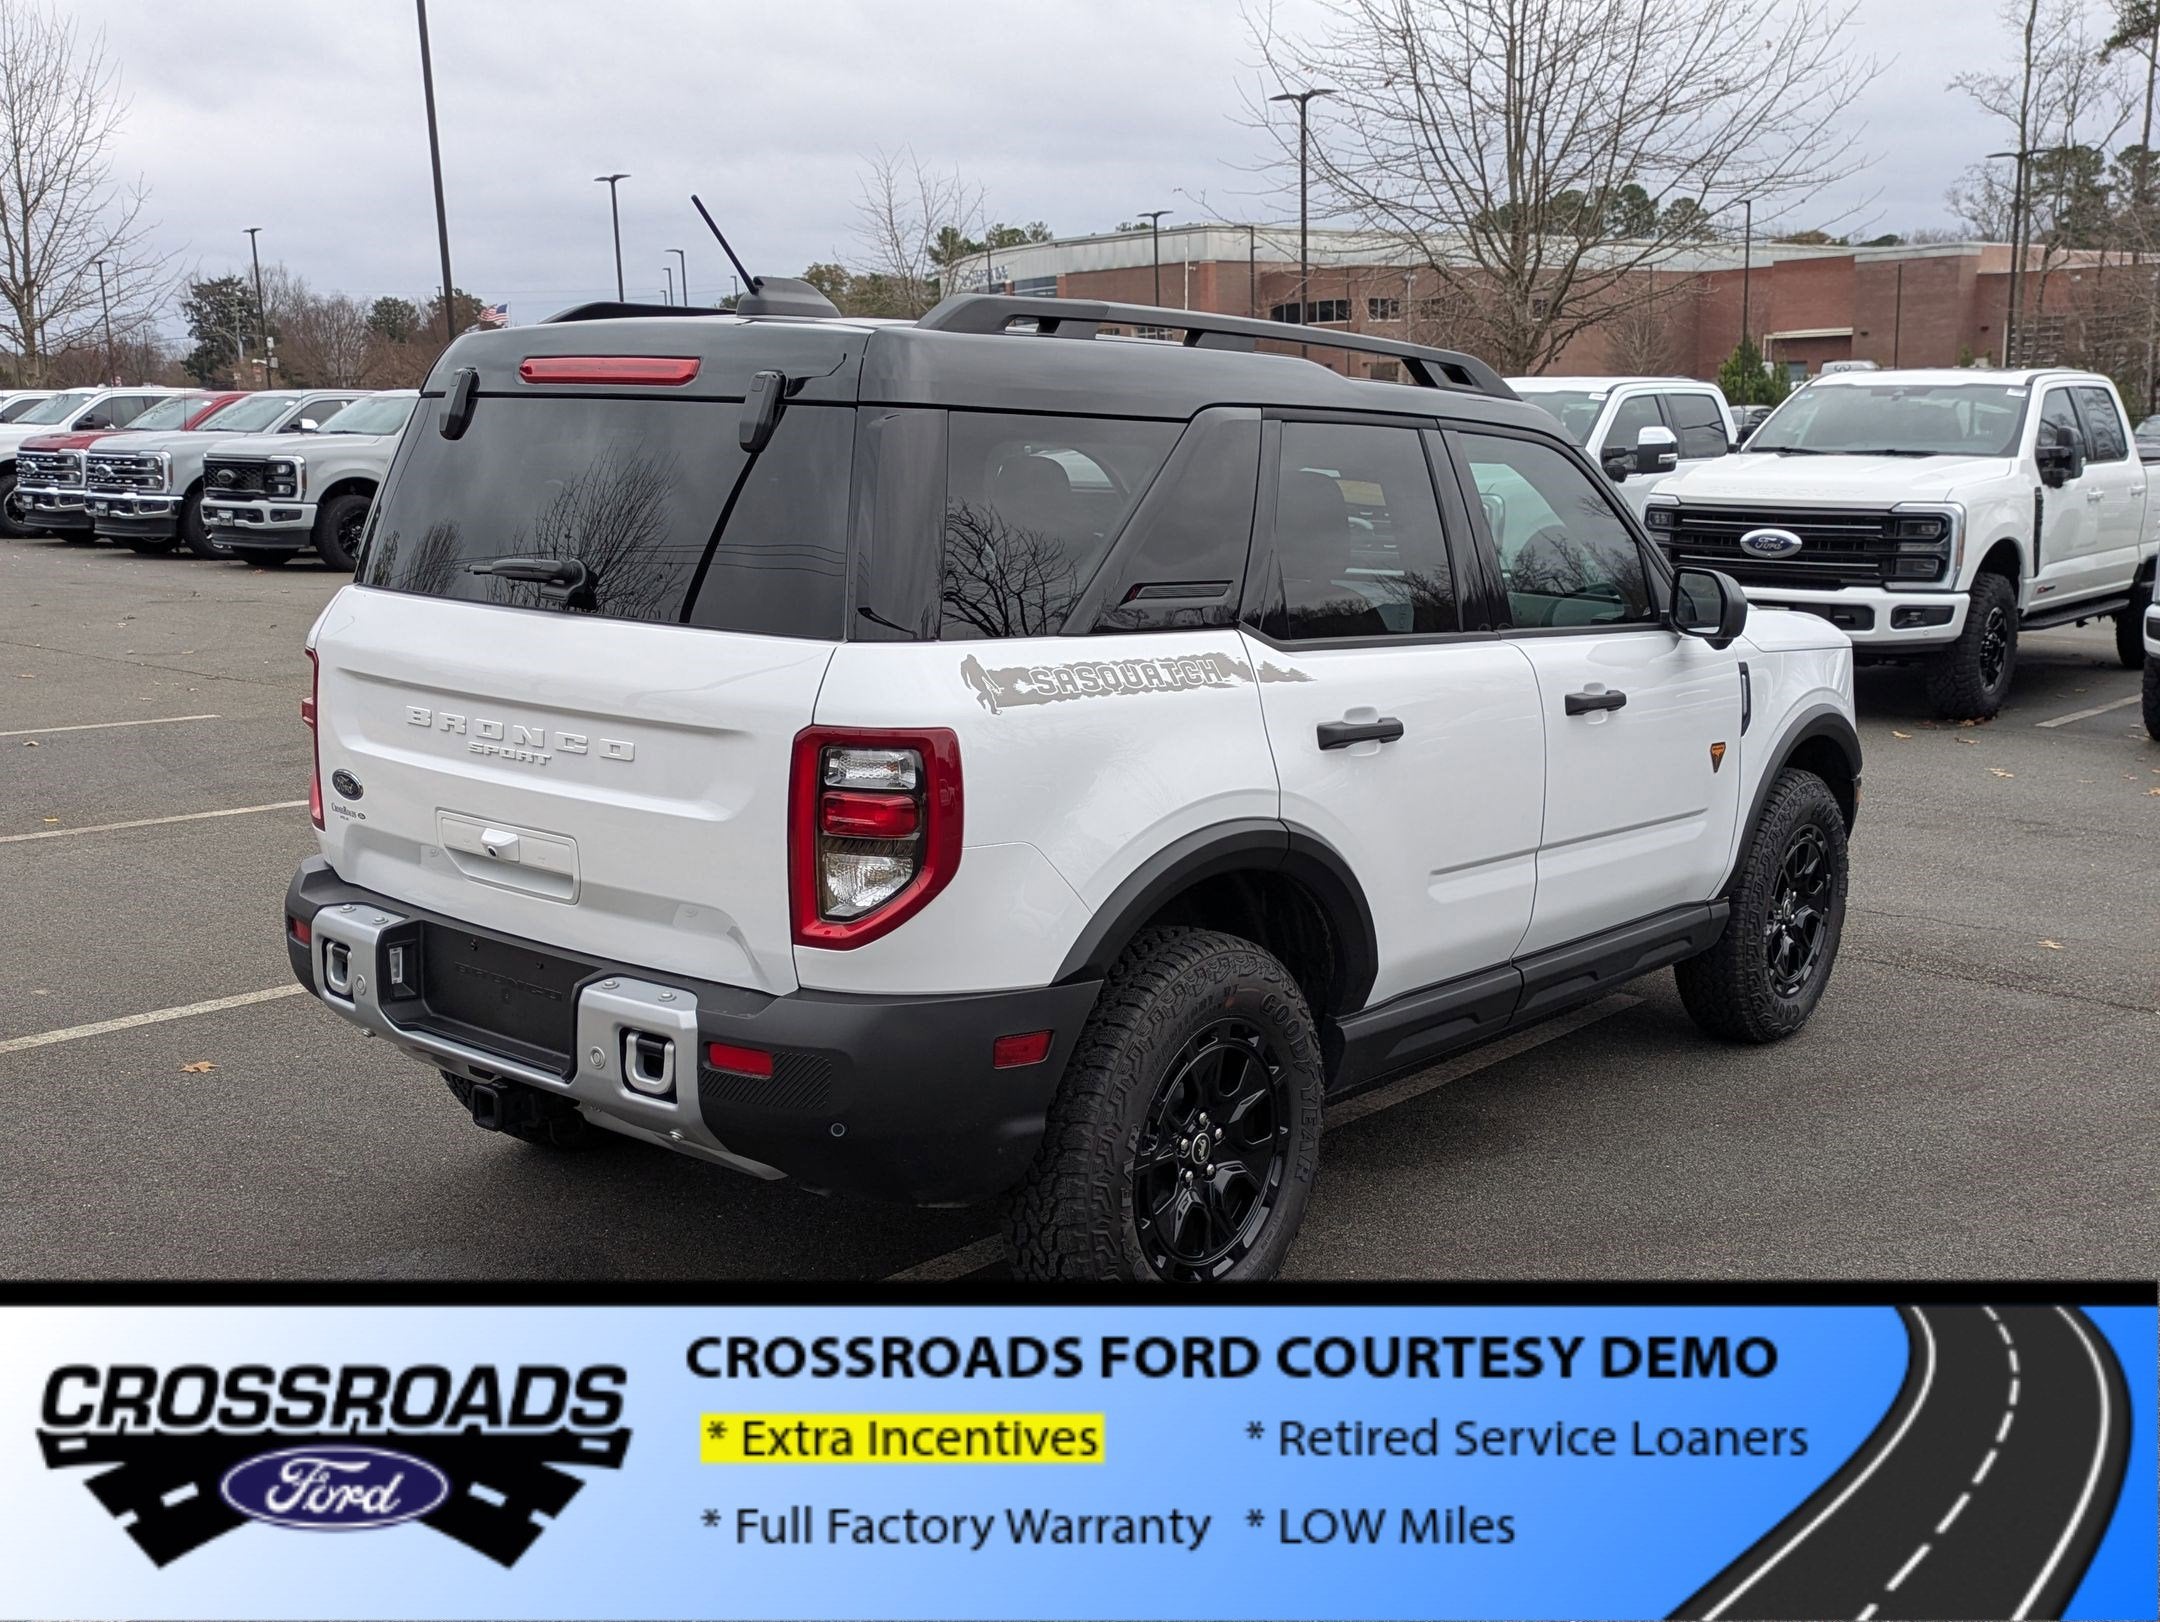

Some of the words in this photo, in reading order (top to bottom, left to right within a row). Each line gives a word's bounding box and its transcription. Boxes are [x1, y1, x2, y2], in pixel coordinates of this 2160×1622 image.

[1755, 536, 1784, 550] Ford
[1028, 659, 1224, 696] SASQUATCH
[405, 705, 635, 762] BRONCO
[467, 741, 551, 765] SPORT
[1260, 993, 1319, 1184] GOODYEAR
